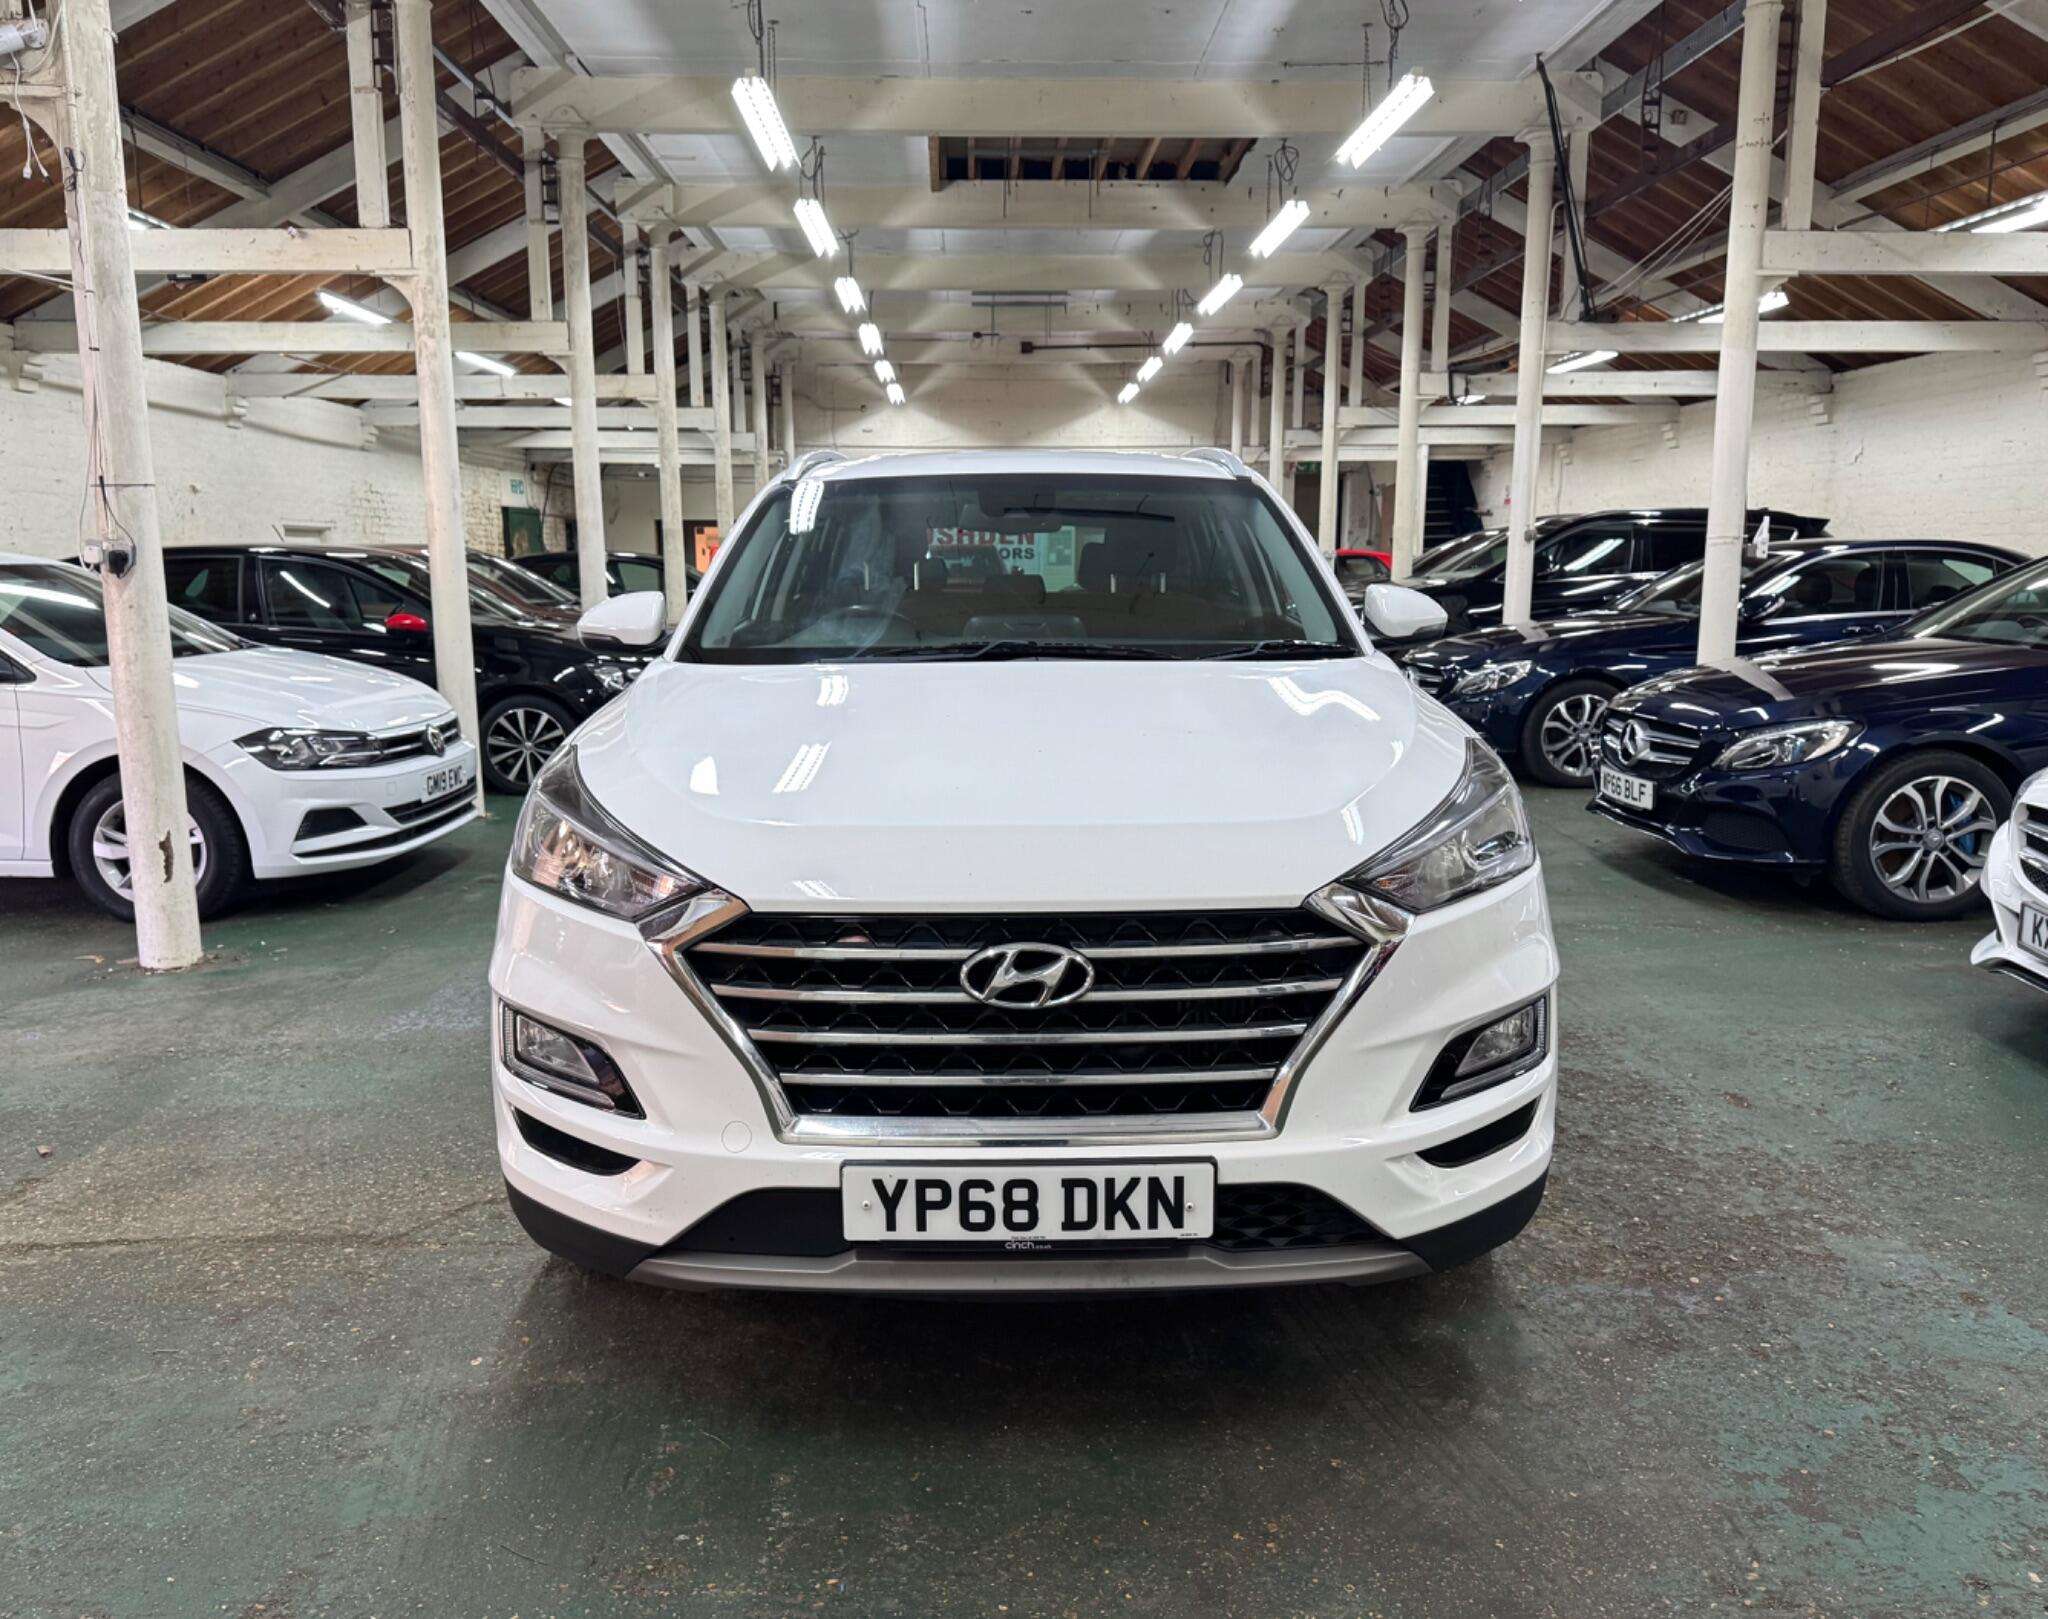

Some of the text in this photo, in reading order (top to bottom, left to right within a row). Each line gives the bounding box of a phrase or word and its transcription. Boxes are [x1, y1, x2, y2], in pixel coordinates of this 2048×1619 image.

[1624, 777, 1647, 803] BLF
[872, 1176, 1185, 1233] YP68 DKN
